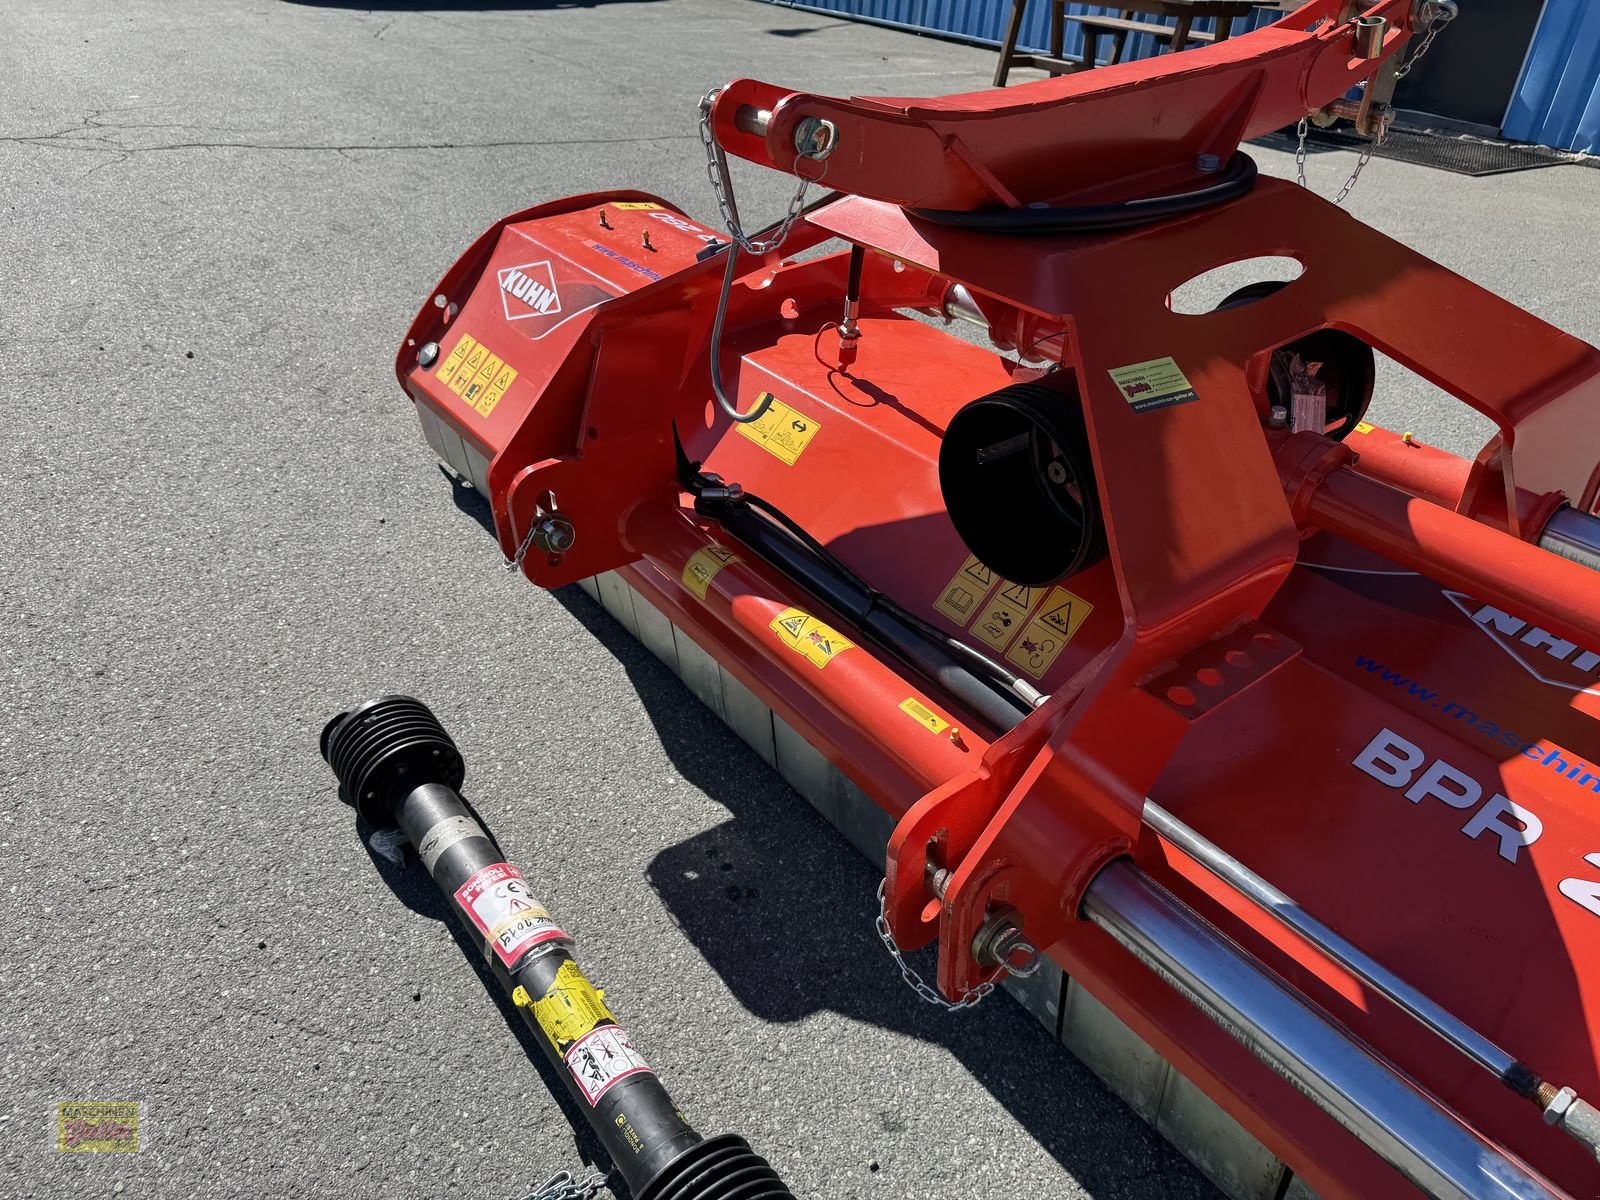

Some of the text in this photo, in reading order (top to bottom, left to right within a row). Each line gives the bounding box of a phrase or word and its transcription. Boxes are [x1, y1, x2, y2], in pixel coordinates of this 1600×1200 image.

[501, 268, 556, 314] KUHN
[1351, 727, 1544, 864] BPR
[462, 867, 503, 898] BONDIOLI
